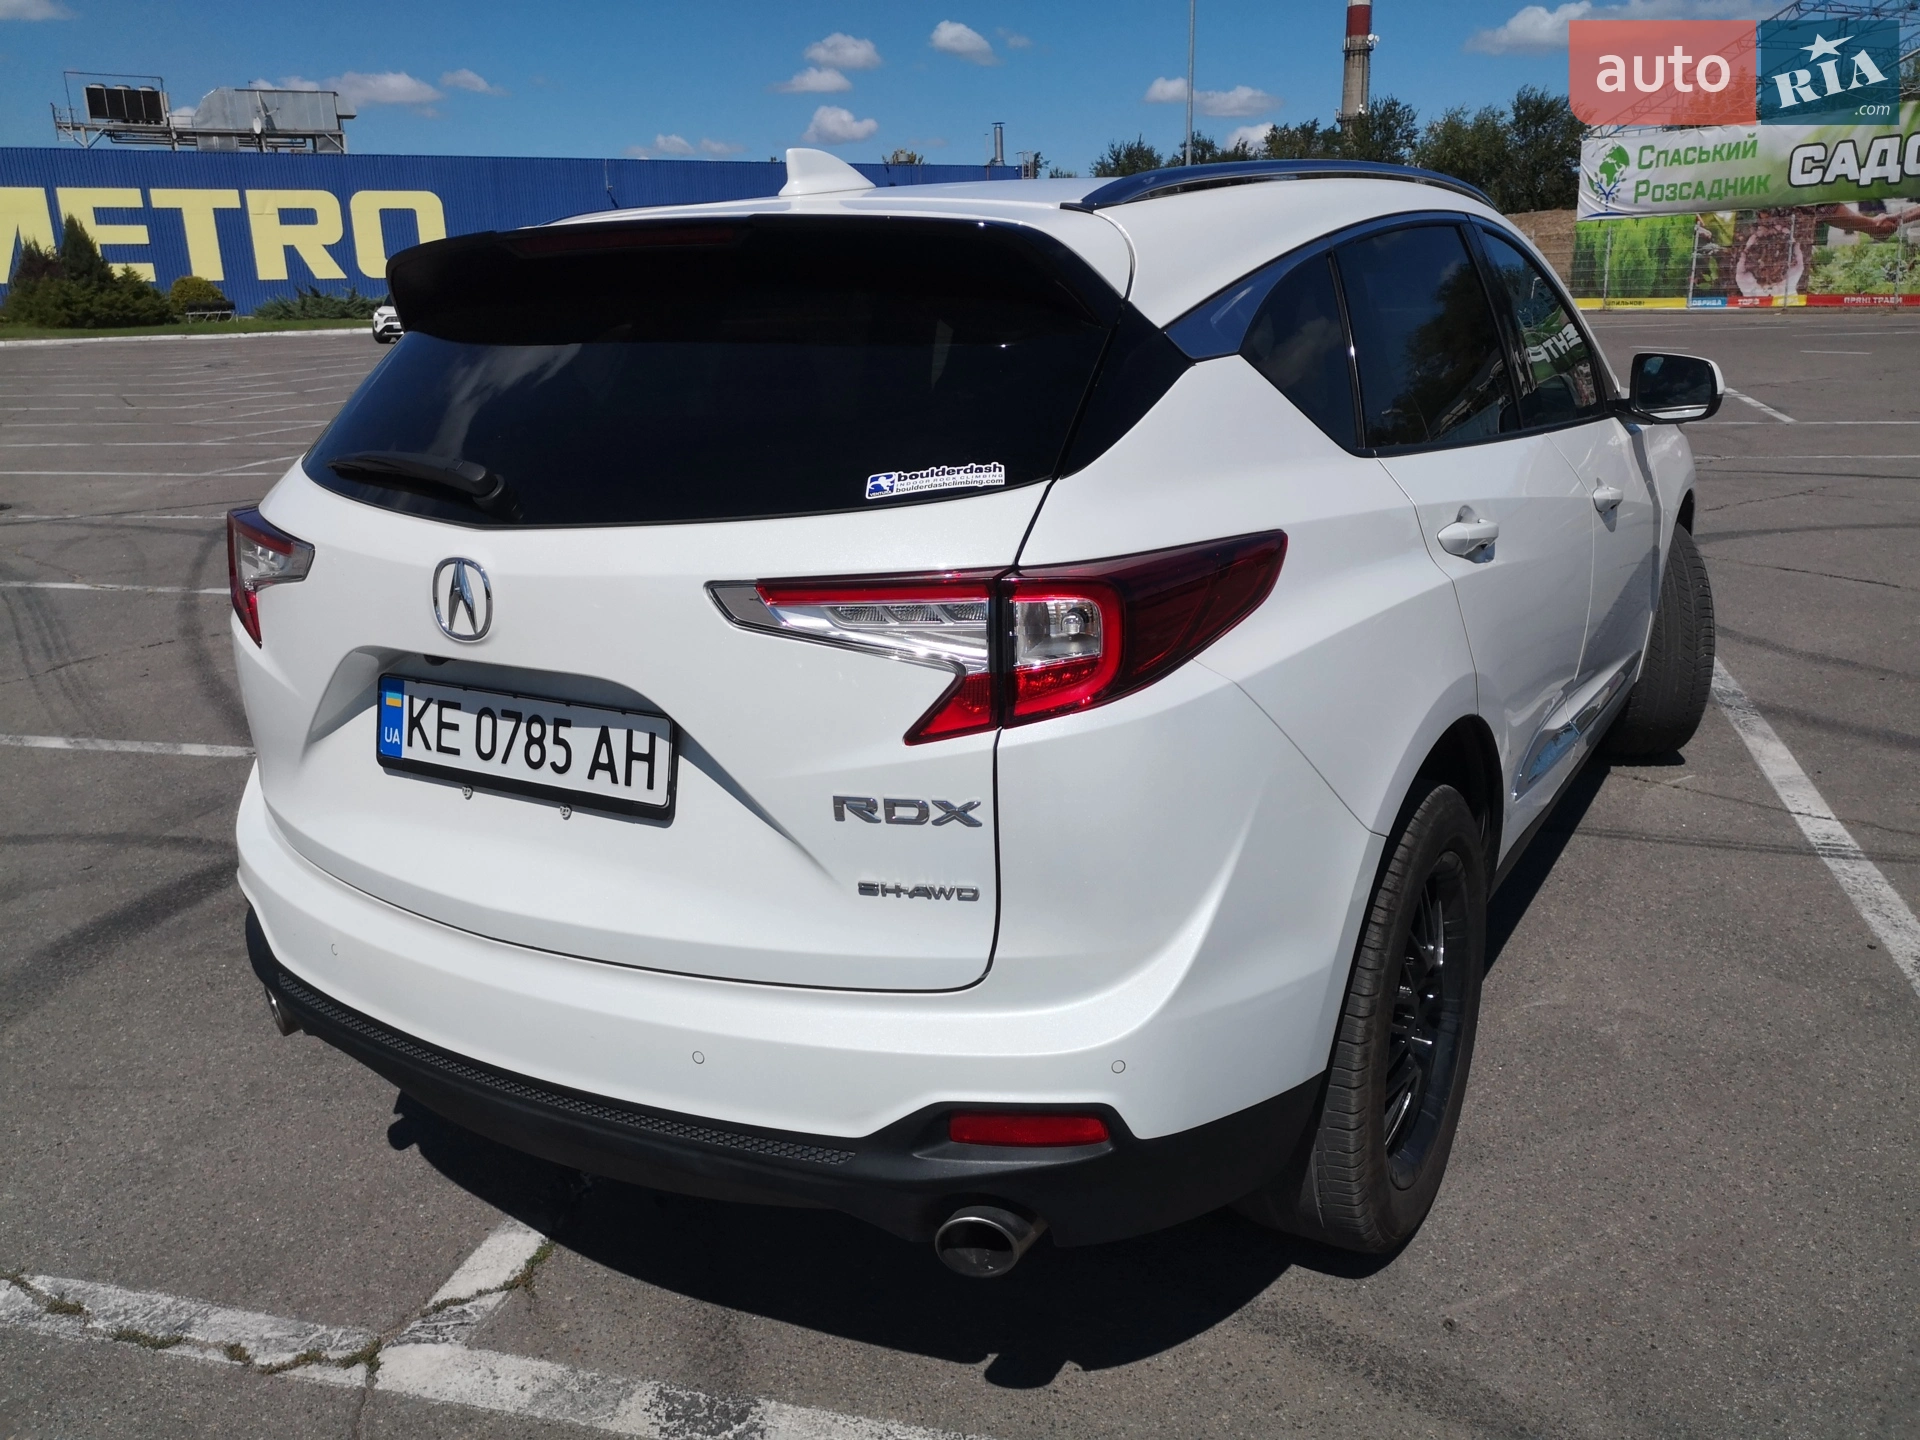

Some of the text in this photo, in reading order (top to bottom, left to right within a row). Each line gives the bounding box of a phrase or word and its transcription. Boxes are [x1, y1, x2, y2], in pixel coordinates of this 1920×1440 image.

[897, 463, 1002, 482] boulderdash
[895, 479, 1003, 493] boulderdashclimbing.com
[384, 727, 400, 745] UA
[407, 695, 657, 791] KE 0785 AH
[832, 795, 983, 828] RDX
[857, 880, 981, 902] SH-AWD
